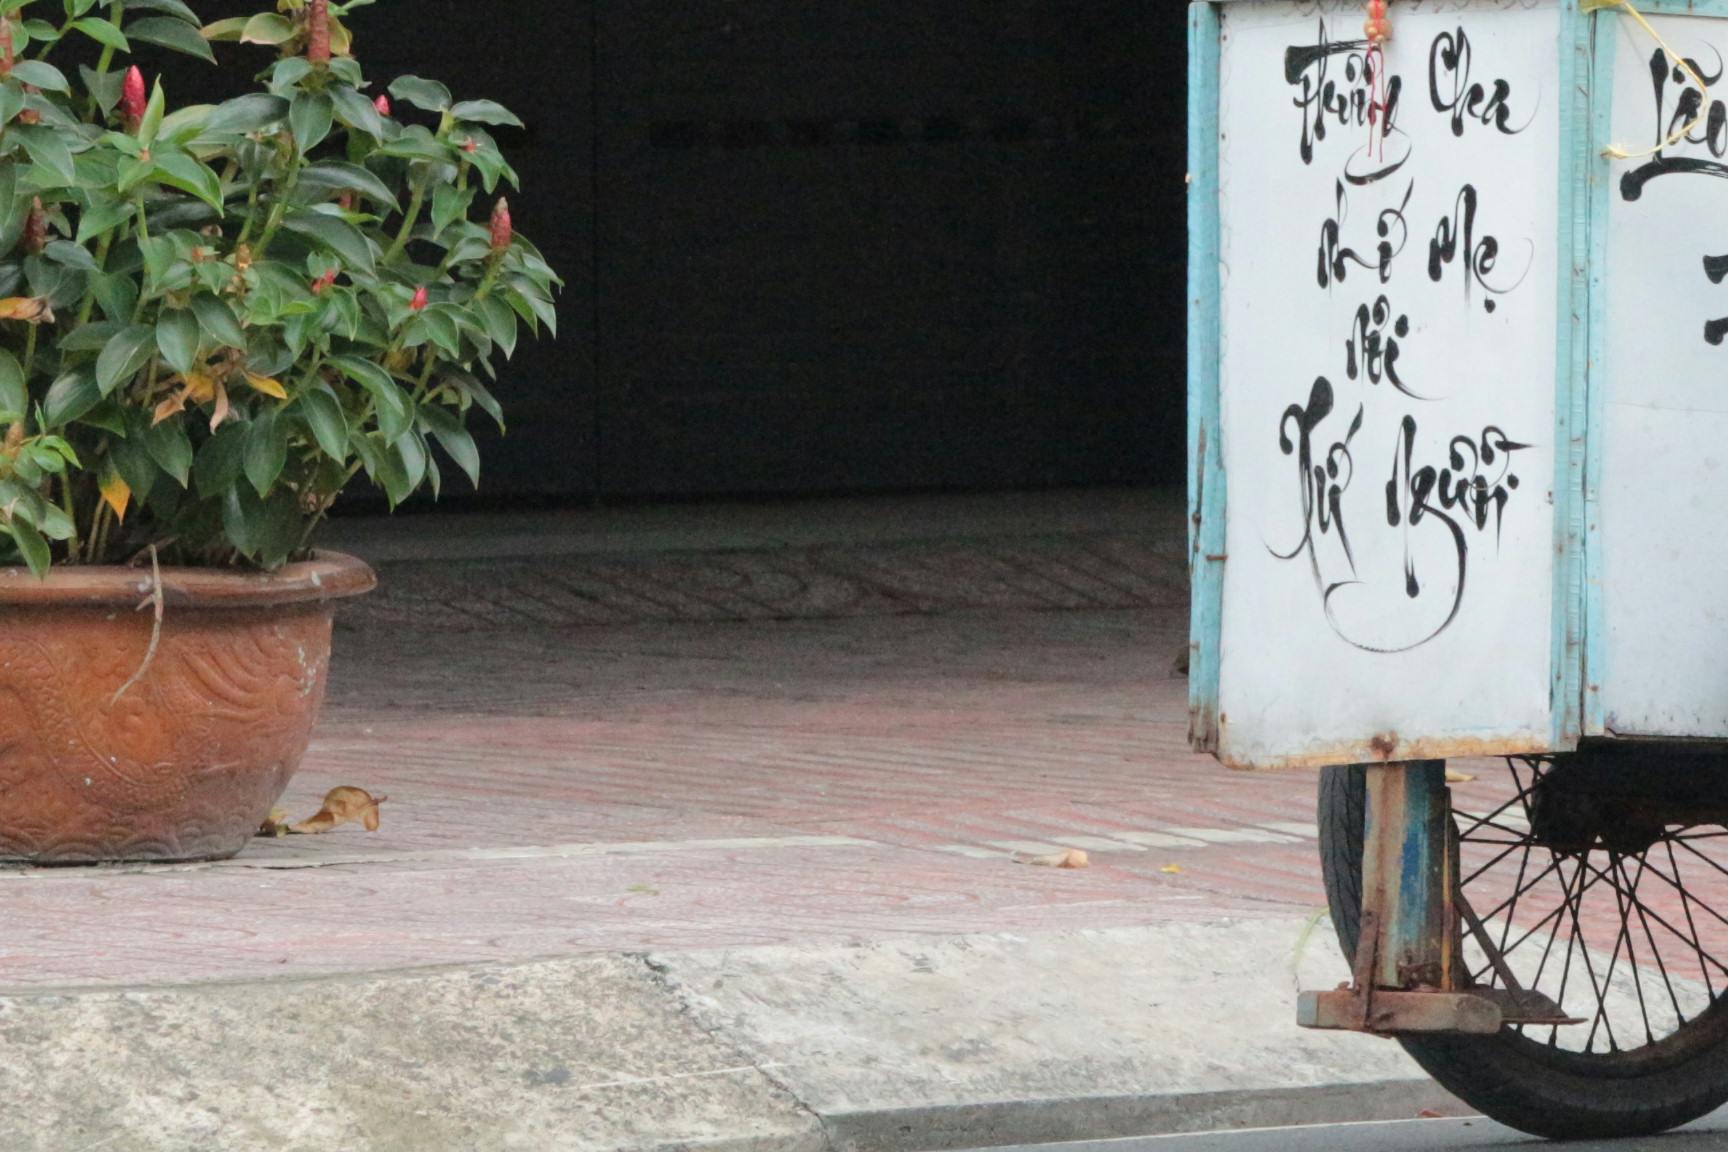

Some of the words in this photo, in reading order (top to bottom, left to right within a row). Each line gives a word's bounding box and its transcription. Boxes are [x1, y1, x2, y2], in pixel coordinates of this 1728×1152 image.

[1428, 26, 1541, 135] Cha
[1428, 184, 1534, 314] Mẹ
[1324, 414, 1539, 653] Người
